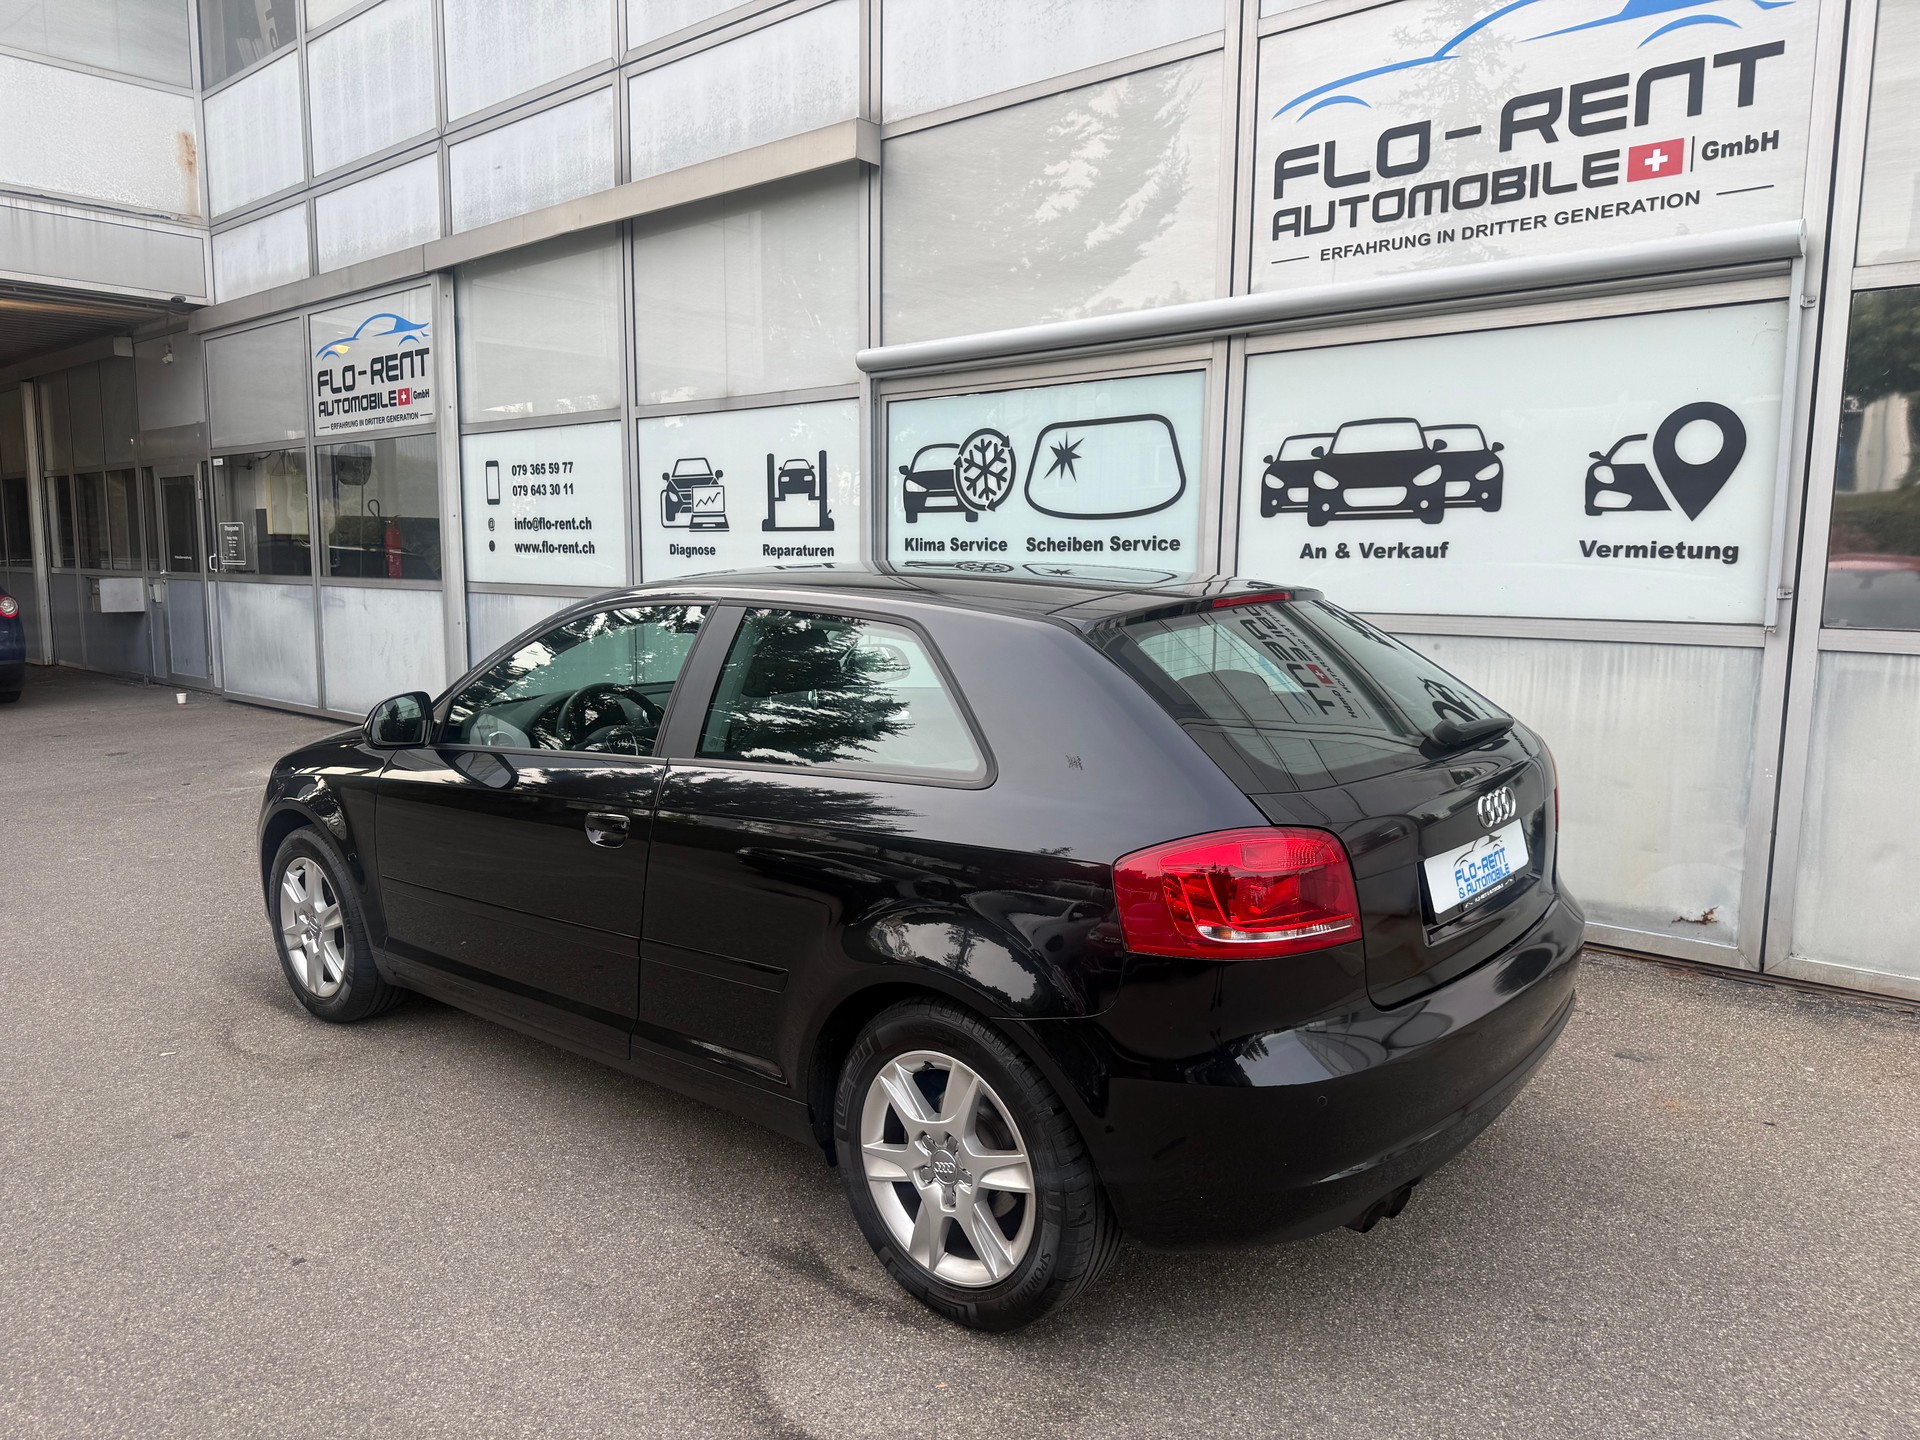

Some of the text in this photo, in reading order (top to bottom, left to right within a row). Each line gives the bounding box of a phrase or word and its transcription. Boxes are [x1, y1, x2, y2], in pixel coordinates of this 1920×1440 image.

[1273, 40, 1785, 200] FLO-RENT
[1272, 130, 1779, 241] AUTOMOBILE GmbH
[1320, 190, 1700, 261] ERFAHRUNG IN DRITTER GENERATION
[317, 347, 430, 397] FLO-RENT
[318, 388, 430, 417] AUTOMOBILE GmbH
[330, 412, 419, 430] ERFAHRUNG IN DRITTER GENERATION
[511, 461, 573, 476] 079 365 59 77
[512, 483, 573, 496] 079 643 30 11
[514, 517, 592, 532] info@flo-rent.ch
[514, 540, 595, 554] www.flo-rent.ch
[669, 544, 716, 558] Diagnose
[763, 544, 834, 559] Reparaturen
[905, 537, 1008, 552] Klima Service
[1026, 535, 1181, 552] Scheiben Service
[1299, 541, 1449, 559] An & Verkauf
[1579, 540, 1739, 565] Vermietung
[1455, 847, 1505, 887] FLO-RENT
[1466, 863, 1510, 896] AUTOMOBILE
